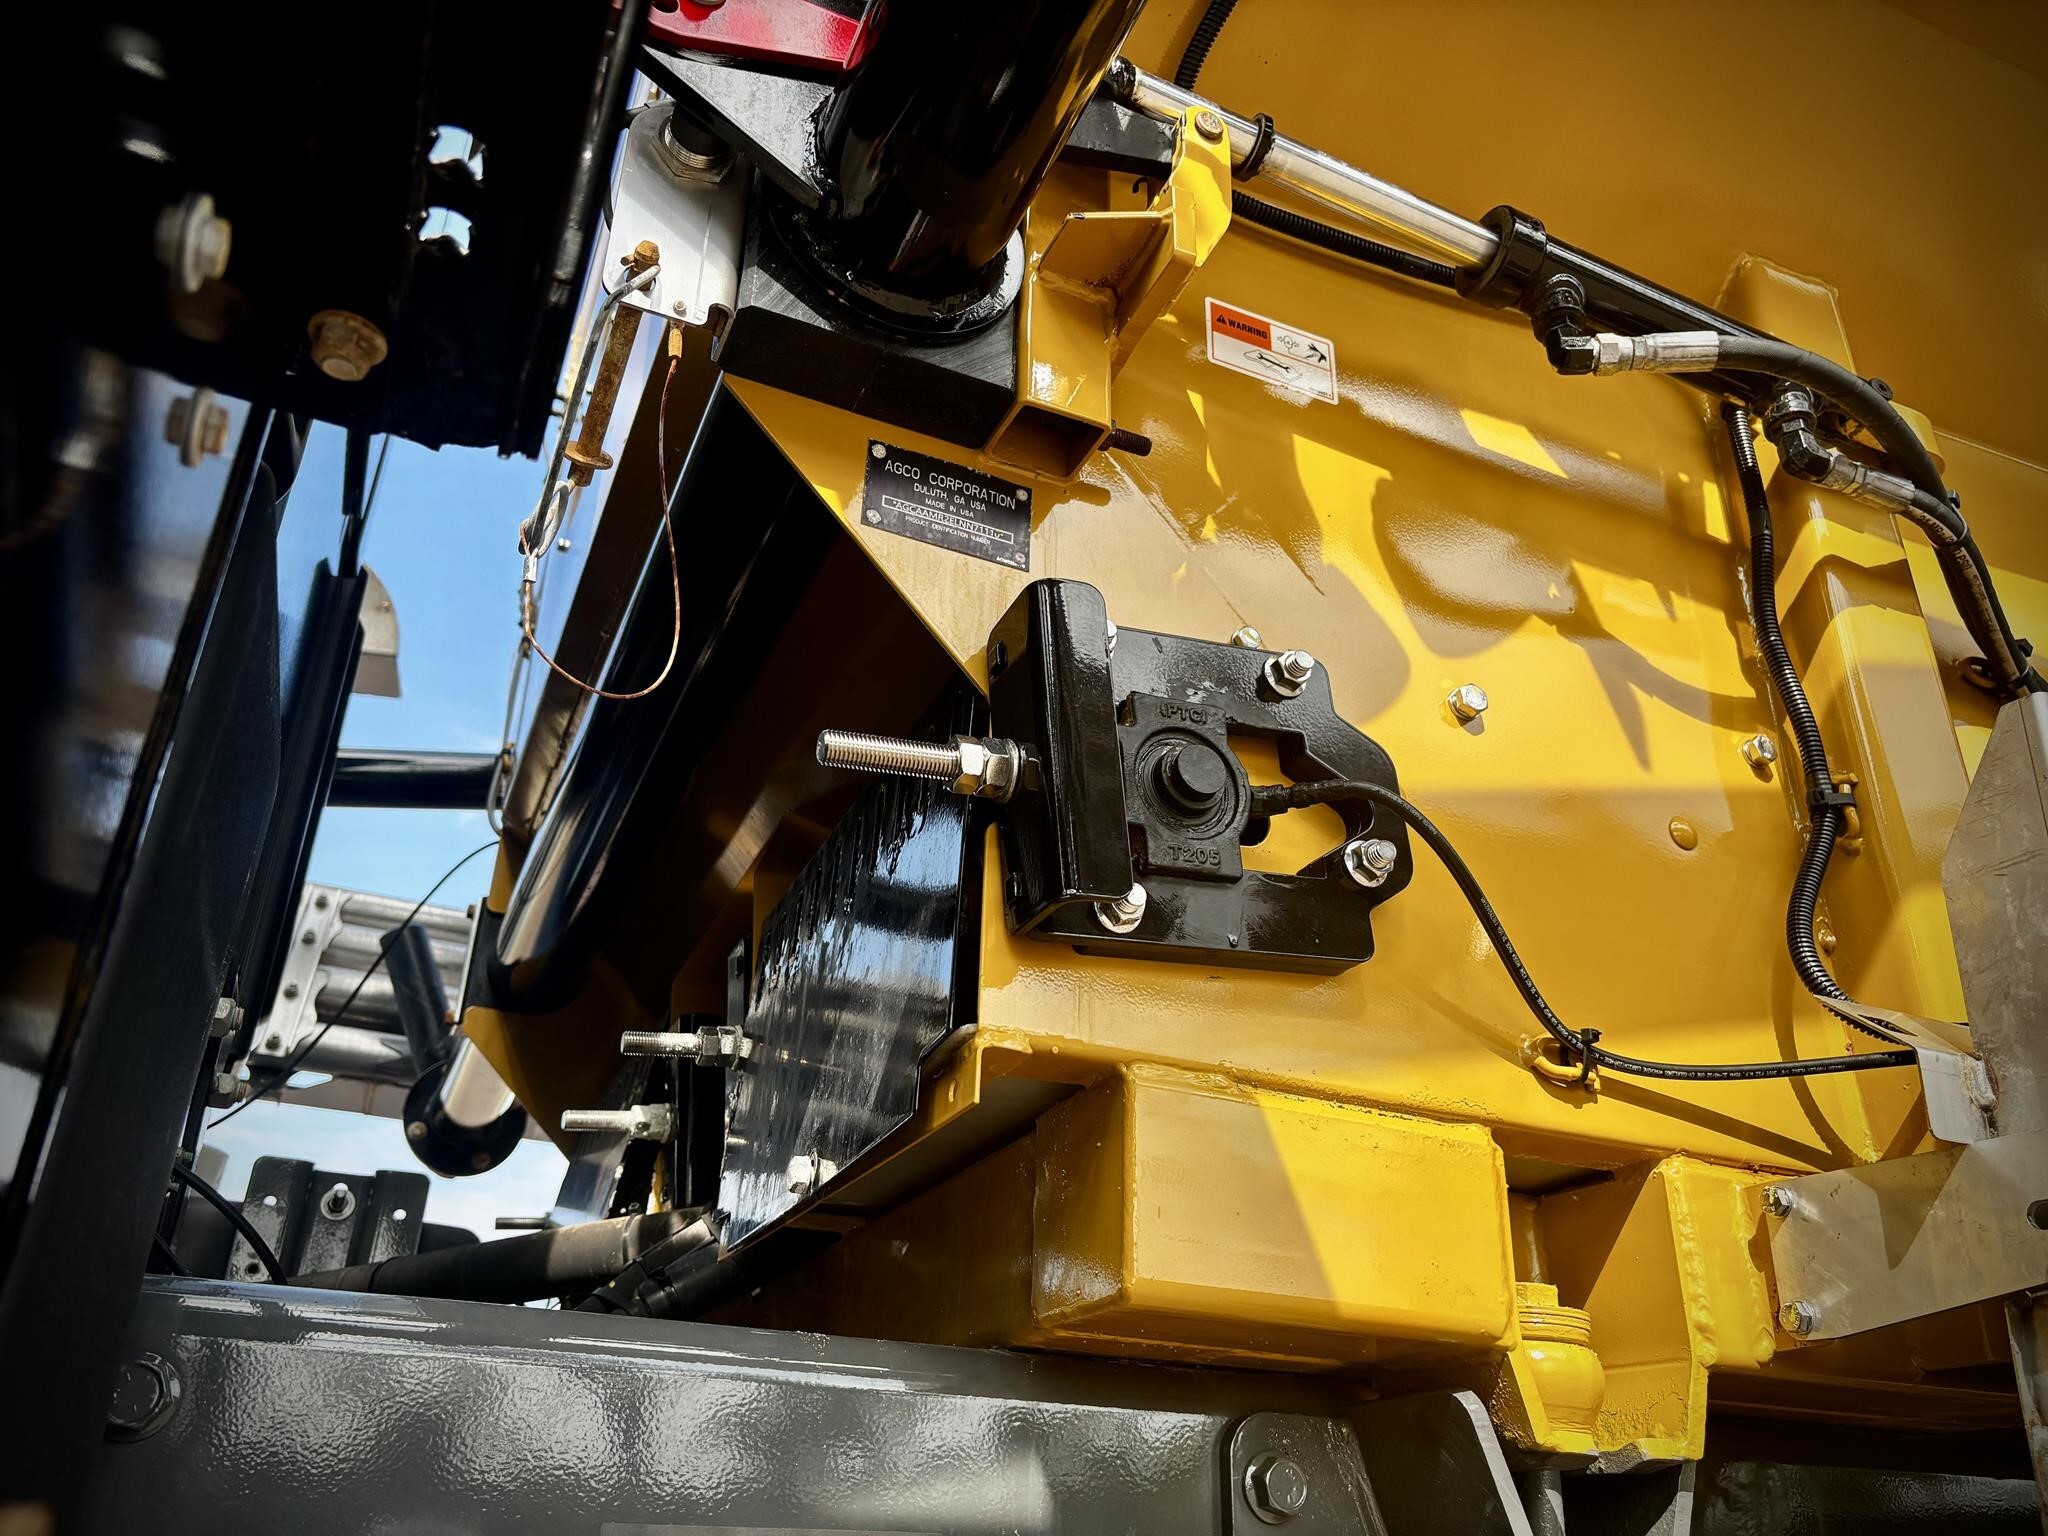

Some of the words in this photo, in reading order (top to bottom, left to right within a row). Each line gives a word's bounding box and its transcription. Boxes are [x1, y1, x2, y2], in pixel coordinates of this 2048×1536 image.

[1227, 318, 1267, 340] WARNING
[884, 460, 921, 480] AGCO
[929, 473, 1016, 510] CORPORATION
[914, 482, 949, 501] DULUTH,
[954, 495, 965, 505] GA
[971, 501, 987, 512] USA
[925, 498, 945, 509] MADE
[949, 505, 957, 513] IN
[960, 507, 974, 518] USA
[1167, 844, 1220, 867] T205
